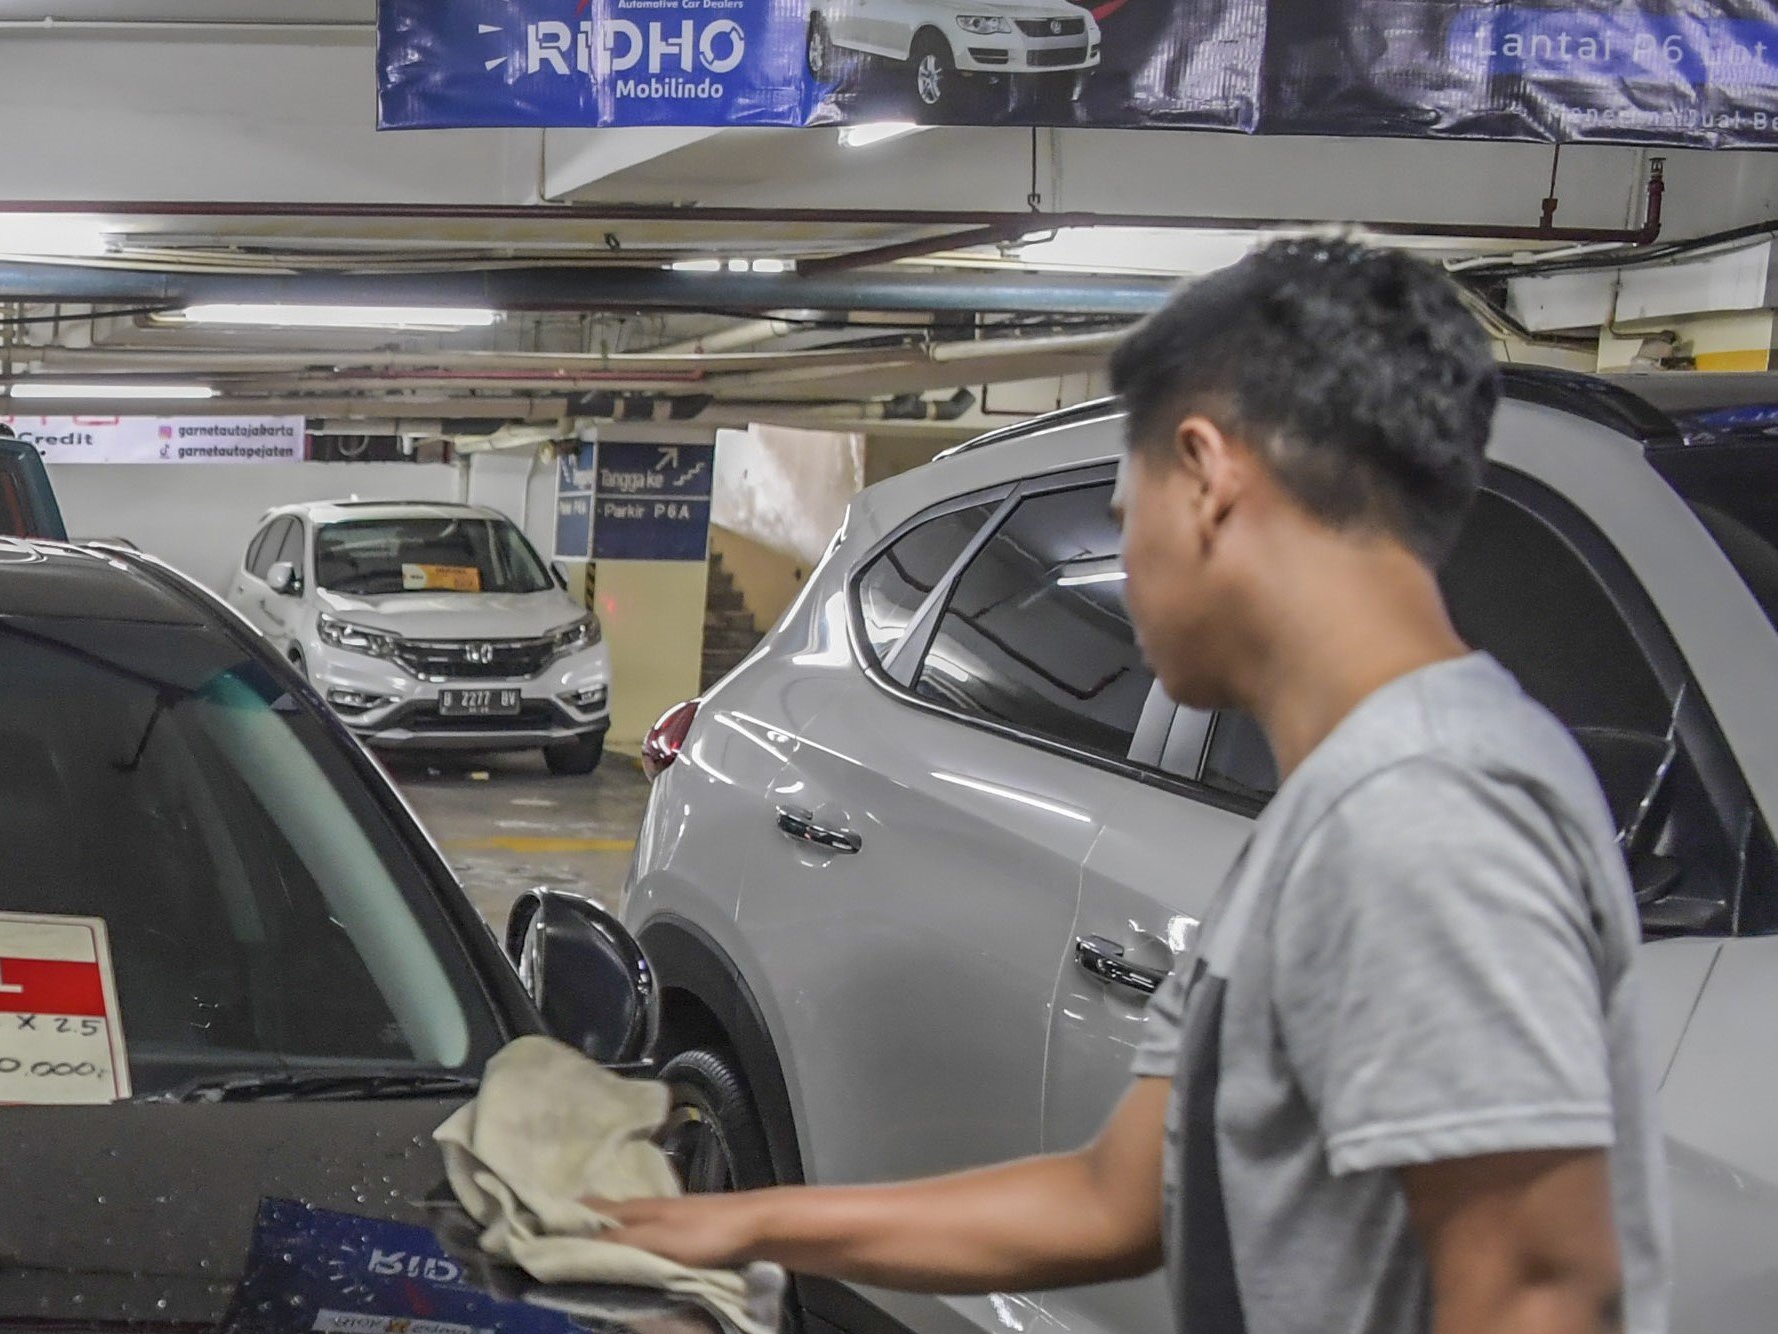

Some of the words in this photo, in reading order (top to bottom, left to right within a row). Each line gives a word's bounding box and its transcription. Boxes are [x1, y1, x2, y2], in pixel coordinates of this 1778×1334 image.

[682, 0, 700, 9] Car
[1474, 26, 1612, 62] Lantai
[616, 78, 724, 99] Mobilindo
[604, 503, 645, 519] Parkir
[17, 1013, 37, 1031] X
[53, 1017, 101, 1037] 2.5
